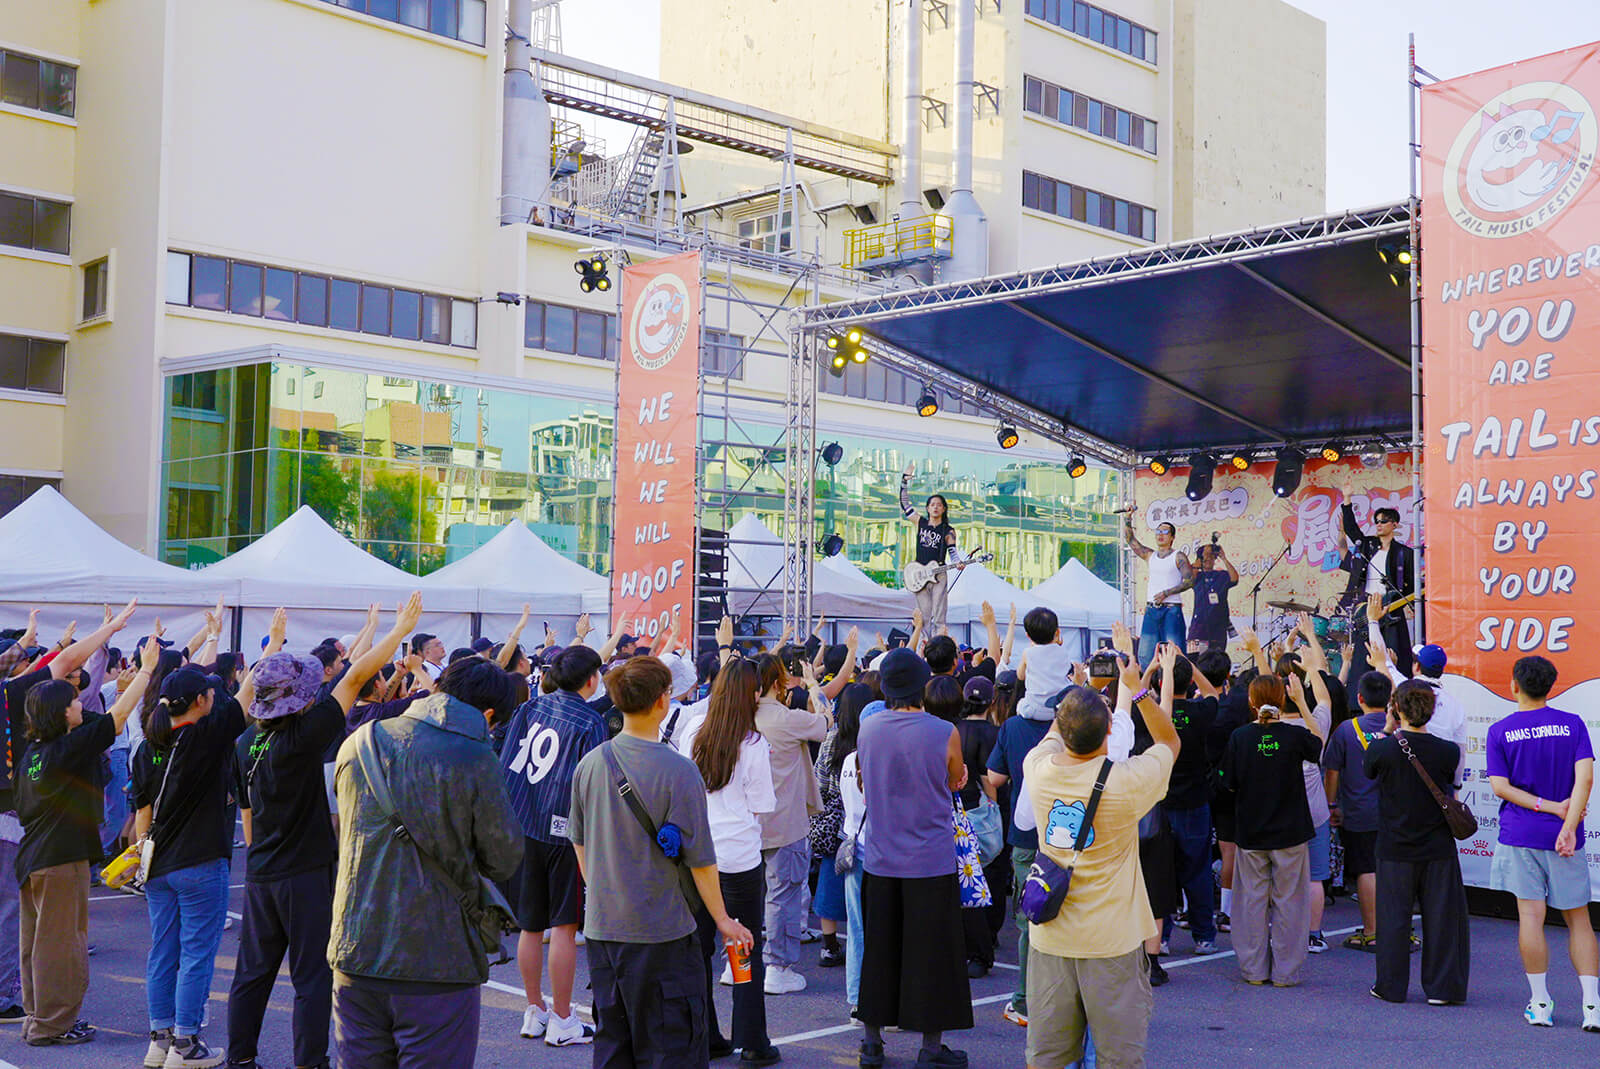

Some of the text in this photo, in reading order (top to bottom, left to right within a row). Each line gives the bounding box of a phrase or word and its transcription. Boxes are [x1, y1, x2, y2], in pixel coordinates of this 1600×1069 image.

[1455, 151, 1593, 236] TAIL MUSIC FESTIVAL
[1441, 244, 1600, 304] WHEREVER
[664, 319, 688, 362] FESTIVAL
[1467, 299, 1576, 351] YOU
[1488, 352, 1555, 386] ARE
[638, 391, 674, 426] WE
[634, 439, 675, 466] WILL
[1440, 408, 1600, 464] TAIL IS
[639, 479, 669, 505] WE
[1454, 469, 1598, 509] ALWAYS
[634, 521, 671, 545] WILL
[1493, 519, 1549, 553] BY
[620, 558, 685, 602] WOOF
[1479, 565, 1576, 600] YOUR
[1474, 616, 1575, 652] SIDE
[1505, 724, 1571, 743] RANAS CORNUDAS
[509, 721, 560, 785] 19
[1480, 849, 1495, 857] CAN
